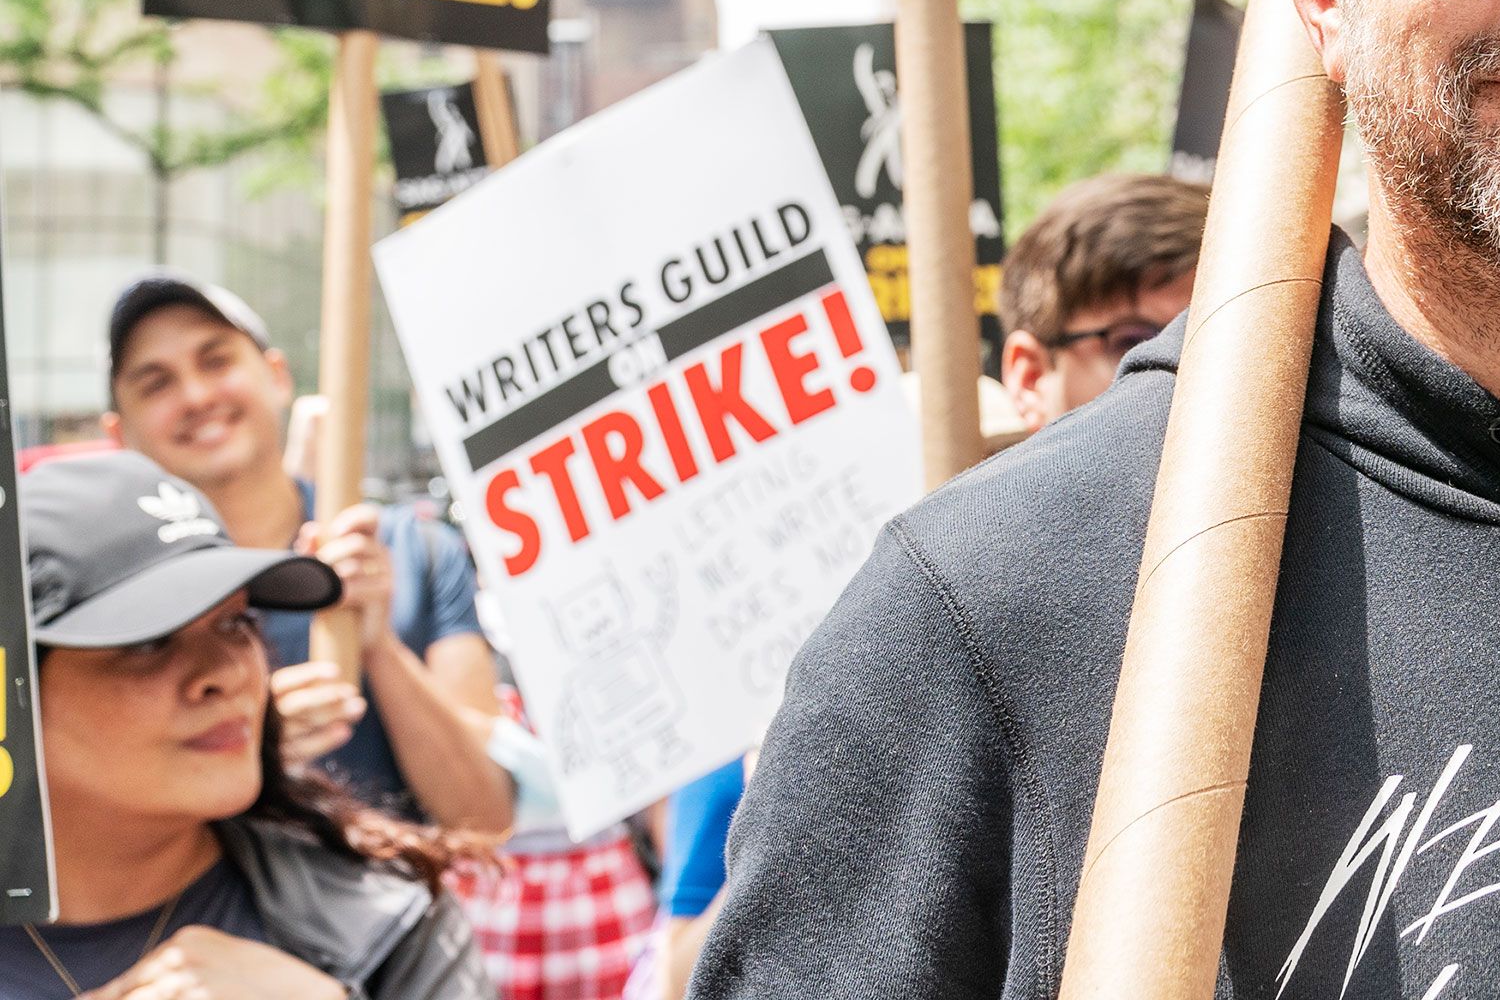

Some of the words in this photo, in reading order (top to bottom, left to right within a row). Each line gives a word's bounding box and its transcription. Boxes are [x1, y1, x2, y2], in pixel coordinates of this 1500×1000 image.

[444, 280, 644, 424] WRITERS
[660, 201, 814, 305] GUILD
[607, 331, 668, 392] ON
[485, 289, 879, 577] STRIKE!
